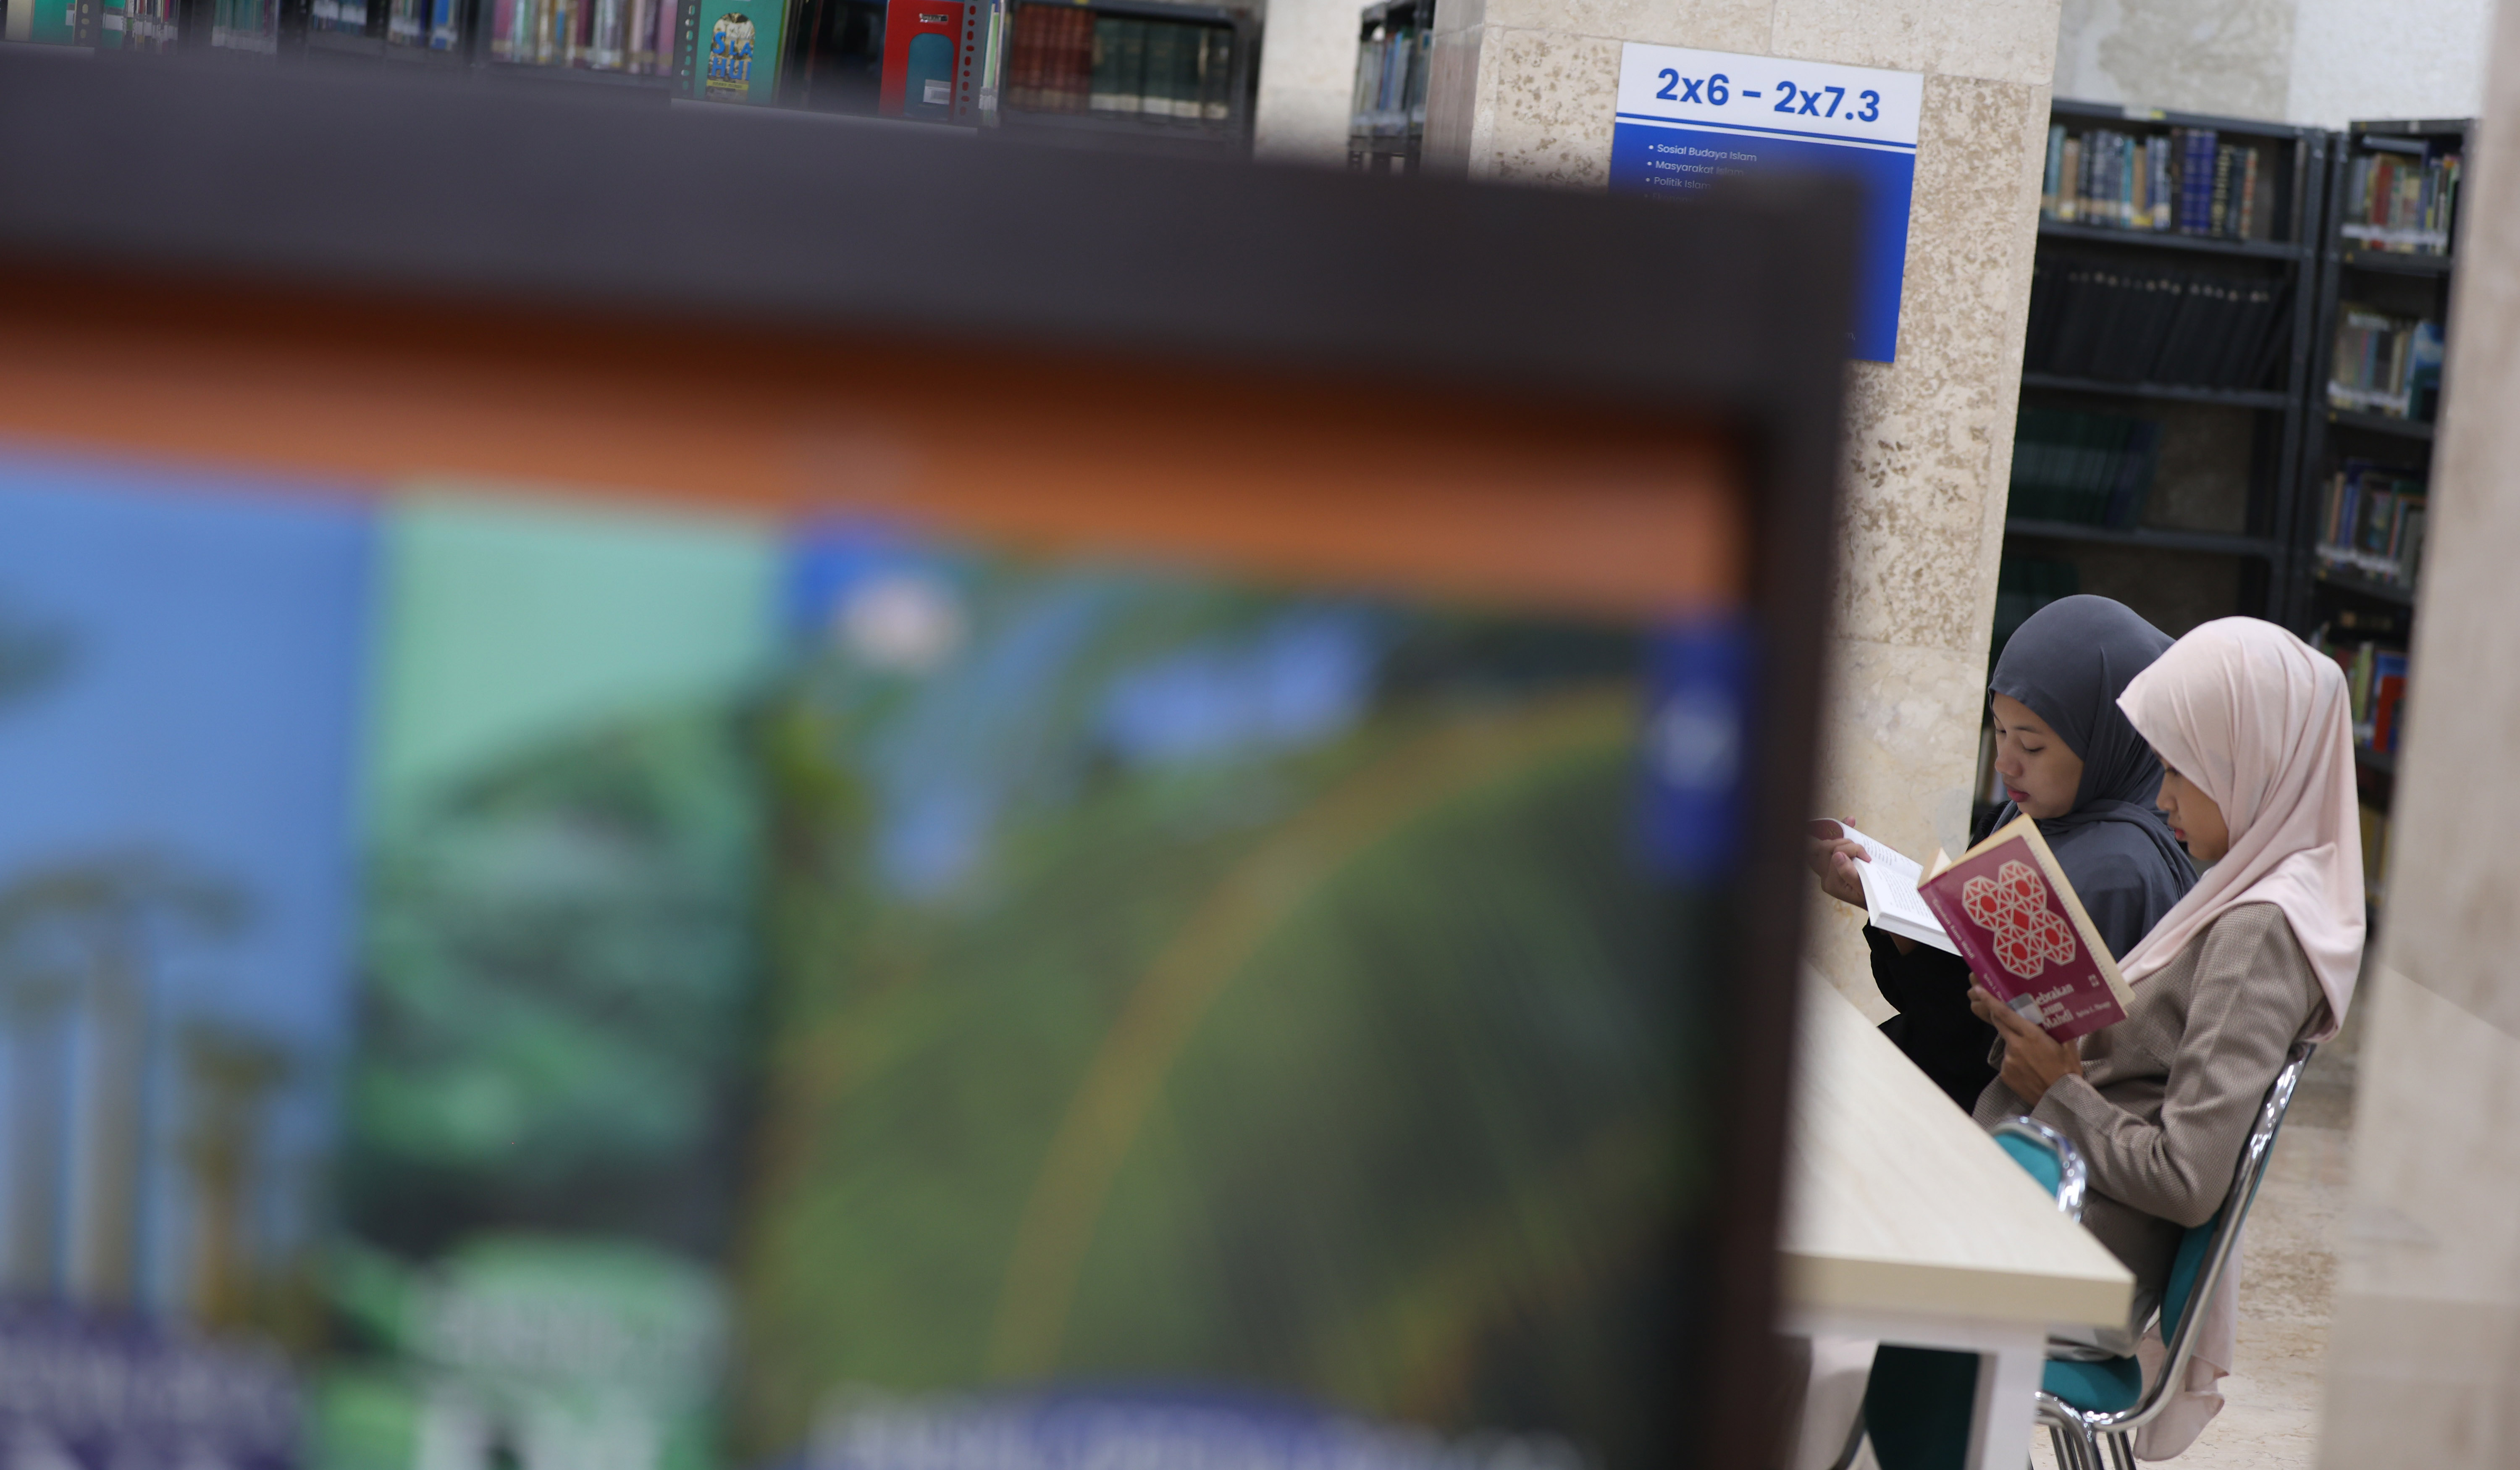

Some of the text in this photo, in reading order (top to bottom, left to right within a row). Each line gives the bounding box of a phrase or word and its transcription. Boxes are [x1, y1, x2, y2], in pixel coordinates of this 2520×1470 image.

[1656, 68, 1730, 105] 2x6
[1774, 81, 1880, 122] 2x7.3
[1657, 144, 1757, 162] Sosial Budaya Islam
[1655, 160, 1744, 177] Masyarakat Islam
[1654, 176, 1712, 190] Politik Islam
[2036, 983, 2074, 1006] ebrakan
[2042, 1001, 2064, 1016] aum
